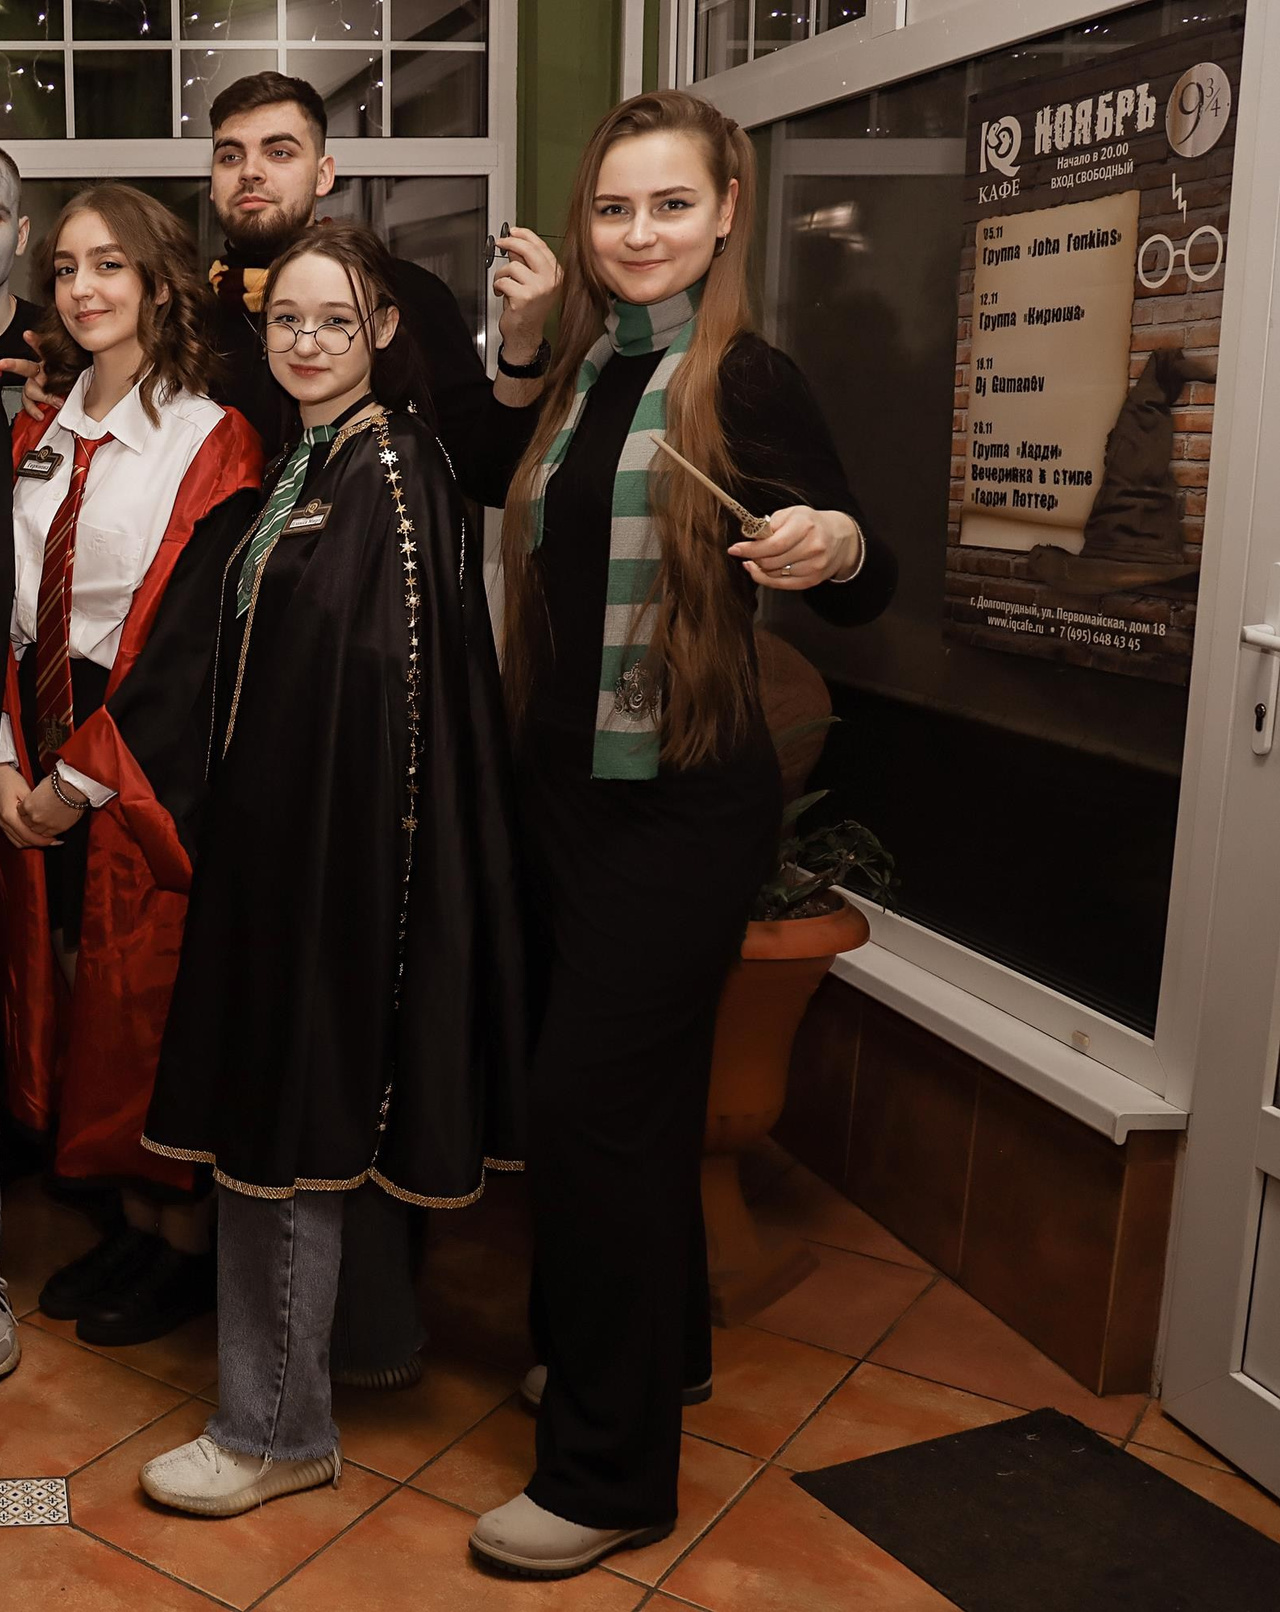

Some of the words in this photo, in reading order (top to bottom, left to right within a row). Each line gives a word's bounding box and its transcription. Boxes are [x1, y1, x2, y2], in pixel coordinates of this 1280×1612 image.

[1034, 82, 1157, 155] НОЯБРЬ
[1057, 154, 1091, 170] Начало
[1092, 151, 1099, 162] в
[1100, 142, 1129, 160] 20.00
[1051, 172, 1074, 190] ВХОД
[1075, 158, 1134, 185] СВОБОДНЫЙ
[978, 179, 1020, 204] КАФЕ
[982, 245, 1021, 266] Группа
[980, 292, 998, 306] 12.11
[979, 312, 1017, 331] Группа
[973, 421, 993, 434] 26.11
[972, 440, 1010, 461] Группа
[971, 464, 1033, 485] Вечеринка
[970, 596, 976, 606] г.
[976, 595, 1040, 618] Долгопрудный,
[1041, 607, 1054, 620] ул.
[1056, 607, 1127, 632] Первомайская,
[1128, 621, 1150, 634] дом
[1152, 622, 1166, 636] 18
[987, 616, 1044, 633] www.iqcafe.ru
[1060, 626, 1066, 638] 7
[1067, 625, 1091, 645] (495)
[1092, 631, 1112, 646] 648
[1113, 635, 1126, 649] 43
[1128, 638, 1141, 651] 45
